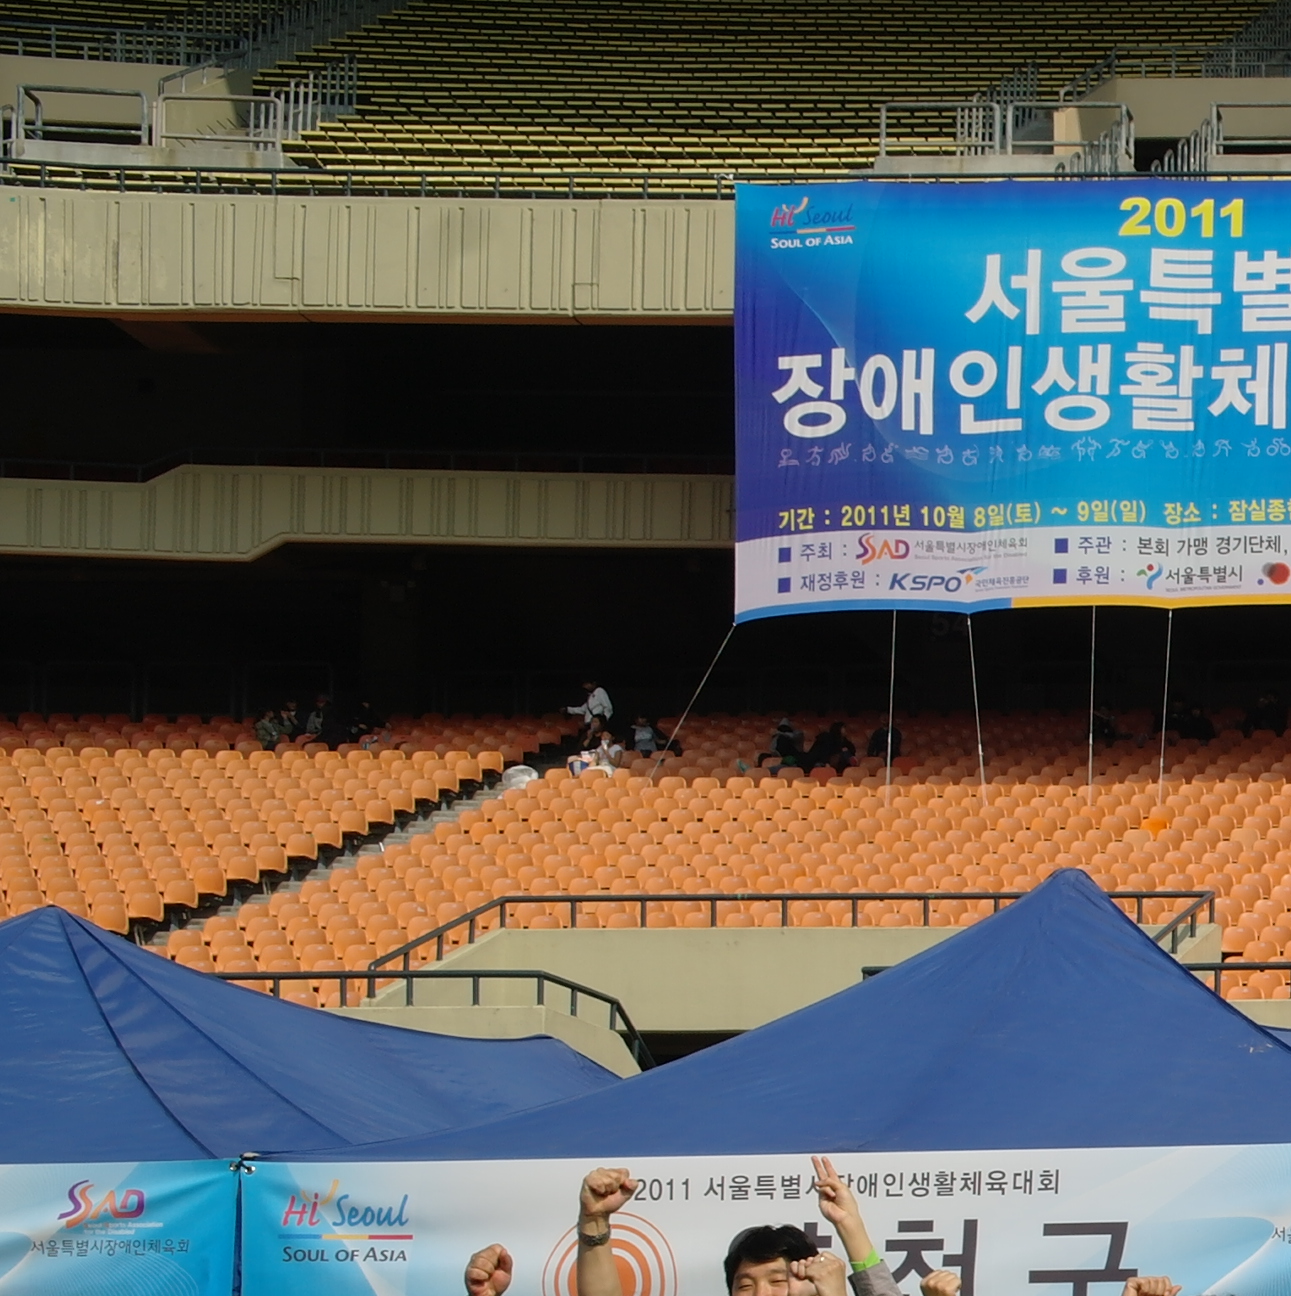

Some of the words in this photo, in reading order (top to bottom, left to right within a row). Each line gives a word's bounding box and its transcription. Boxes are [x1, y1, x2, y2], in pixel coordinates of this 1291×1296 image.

[771, 204, 796, 227] Hi
[803, 203, 853, 225] Seoul
[1119, 196, 1245, 238] 2011
[771, 238, 802, 249] SOUL
[806, 238, 821, 247] OF
[824, 235, 853, 246] ASIA
[779, 508, 815, 531] 기간
[841, 504, 910, 528] 2011년
[921, 506, 965, 529] 10월
[974, 502, 1041, 528] 8일(토)
[1077, 500, 1147, 524] 9일(일)
[1163, 502, 1201, 525] 장소
[800, 541, 832, 562] 주최
[856, 532, 910, 565] SSAD
[914, 537, 1028, 555] 서울특별시장애인체육회
[1077, 536, 1112, 554] 주관
[1137, 536, 1170, 556] 본회
[1177, 536, 1209, 556] 가맹
[1216, 535, 1288, 555] 경기단체,
[800, 571, 865, 592] 재정후원
[889, 573, 962, 593] KSPO
[1076, 565, 1110, 585] 후원
[1165, 564, 1243, 586] 서울특별시
[634, 1177, 691, 1201] 2011
[703, 1168, 1061, 1201] 서울특별애인생활체육대회
[57, 1180, 145, 1229] SSAD
[282, 1194, 320, 1229] Hi
[332, 1194, 409, 1227] Seoul
[30, 1238, 190, 1257] 서울특별시장애인체육회
[282, 1246, 329, 1263] SOUL
[335, 1246, 359, 1262] OF
[363, 1246, 408, 1263] ASIA
